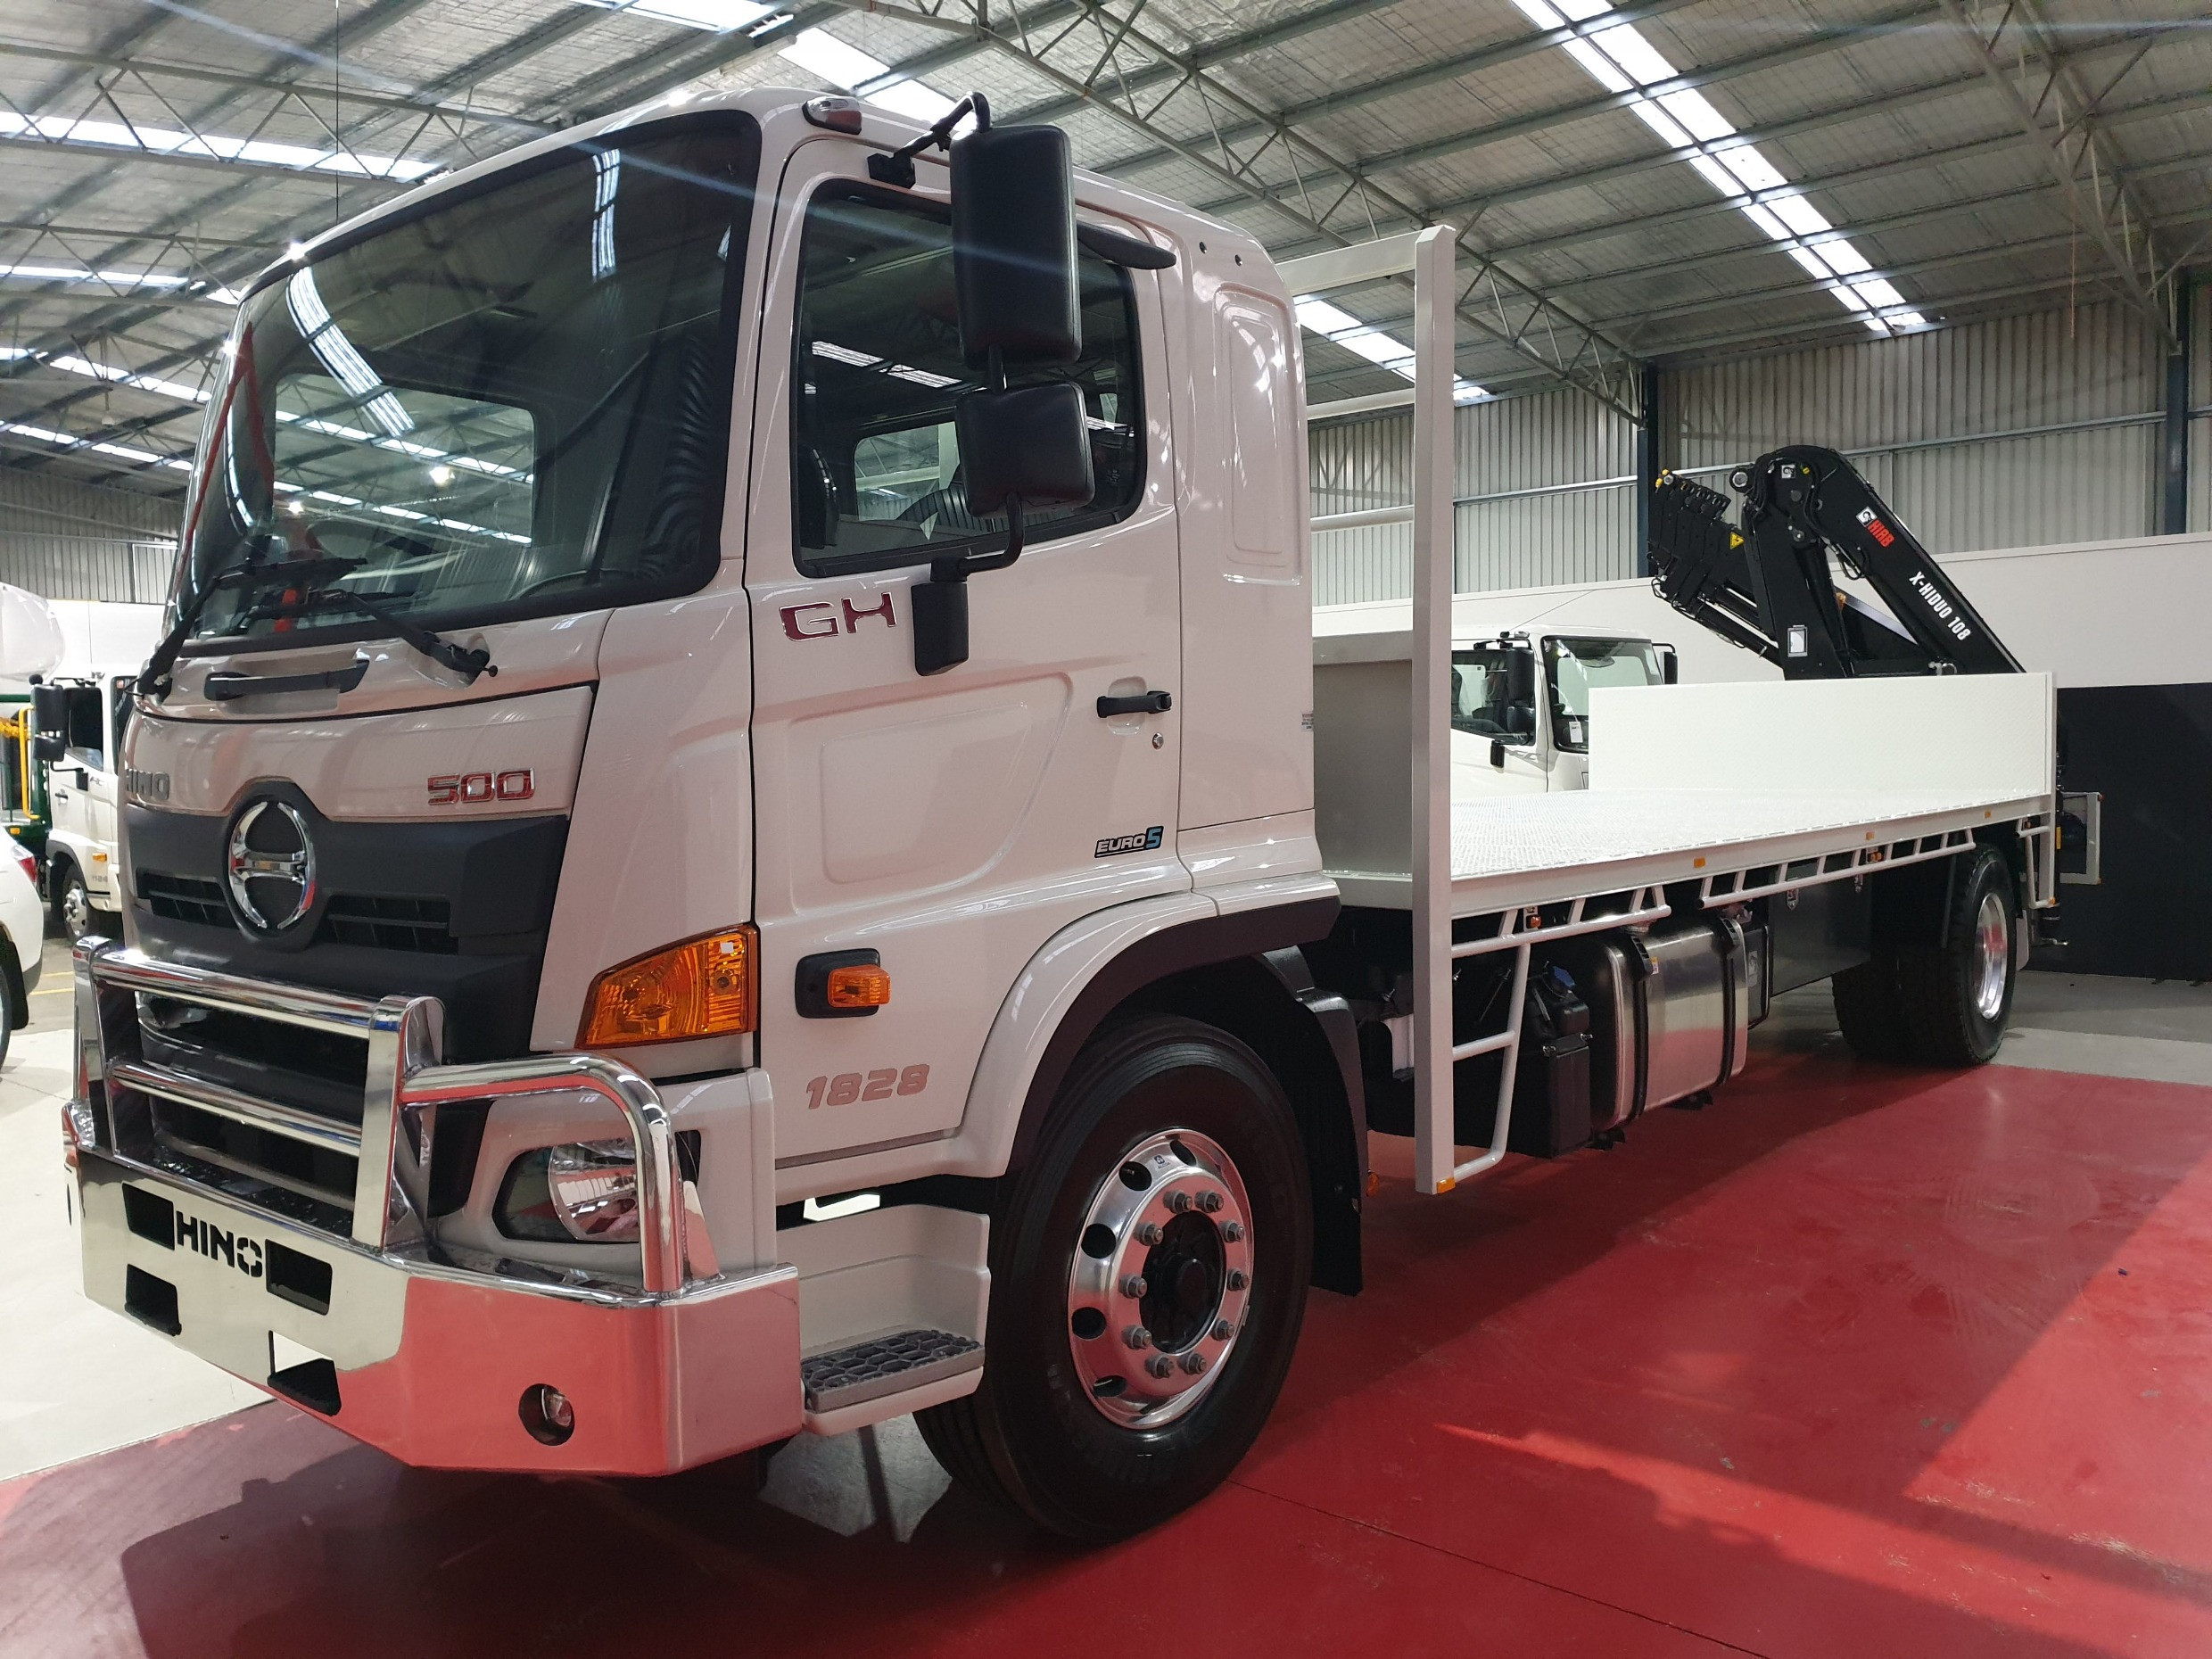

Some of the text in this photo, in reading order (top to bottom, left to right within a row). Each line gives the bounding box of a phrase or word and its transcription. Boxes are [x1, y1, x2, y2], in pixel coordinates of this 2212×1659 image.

[1867, 519, 1895, 548] HIAB
[779, 591, 897, 641] GH
[1909, 571, 1971, 641] X-HIDUO 108
[427, 767, 535, 805] 500
[806, 1063, 930, 1110] 1828
[176, 1210, 263, 1278] HINO
